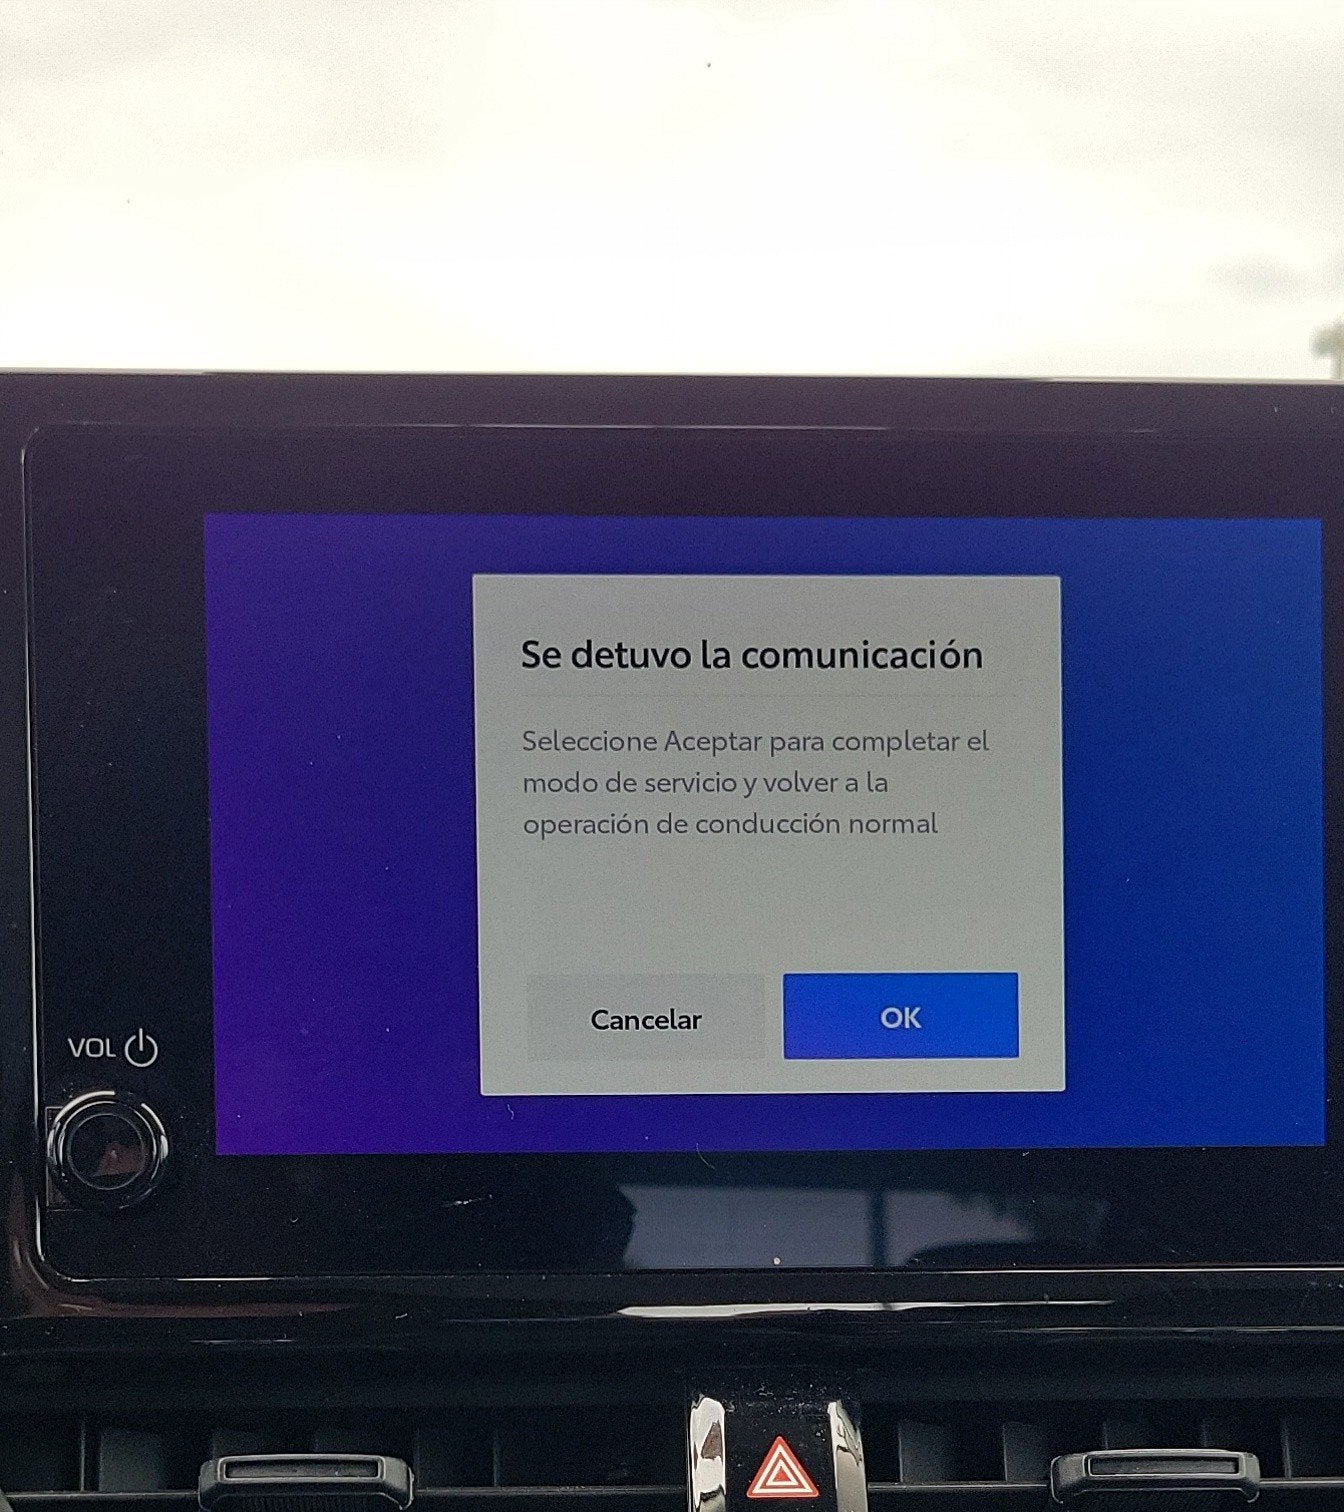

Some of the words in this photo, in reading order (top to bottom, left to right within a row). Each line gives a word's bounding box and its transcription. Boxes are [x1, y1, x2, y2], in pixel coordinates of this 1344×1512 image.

[523, 640, 561, 668] Se
[572, 640, 691, 668] detuvo
[702, 640, 730, 668] la
[743, 640, 982, 669] comunicación
[523, 729, 657, 751] Seleccione
[665, 730, 762, 757] Aceptar
[771, 736, 823, 757] para
[833, 730, 960, 757] completar
[968, 730, 989, 751] el
[524, 771, 598, 792] modo
[606, 771, 637, 792] de
[645, 772, 737, 793] servicio
[744, 778, 757, 798] y
[763, 771, 838, 792] volver
[846, 778, 858, 792] a
[867, 771, 887, 792] la
[524, 813, 648, 840] operación
[657, 812, 688, 833] de
[696, 812, 839, 833] conducción
[850, 812, 938, 833] normal
[592, 1008, 702, 1029] Cancelar
[881, 1007, 921, 1028] OK
[68, 1038, 116, 1057] VOL
